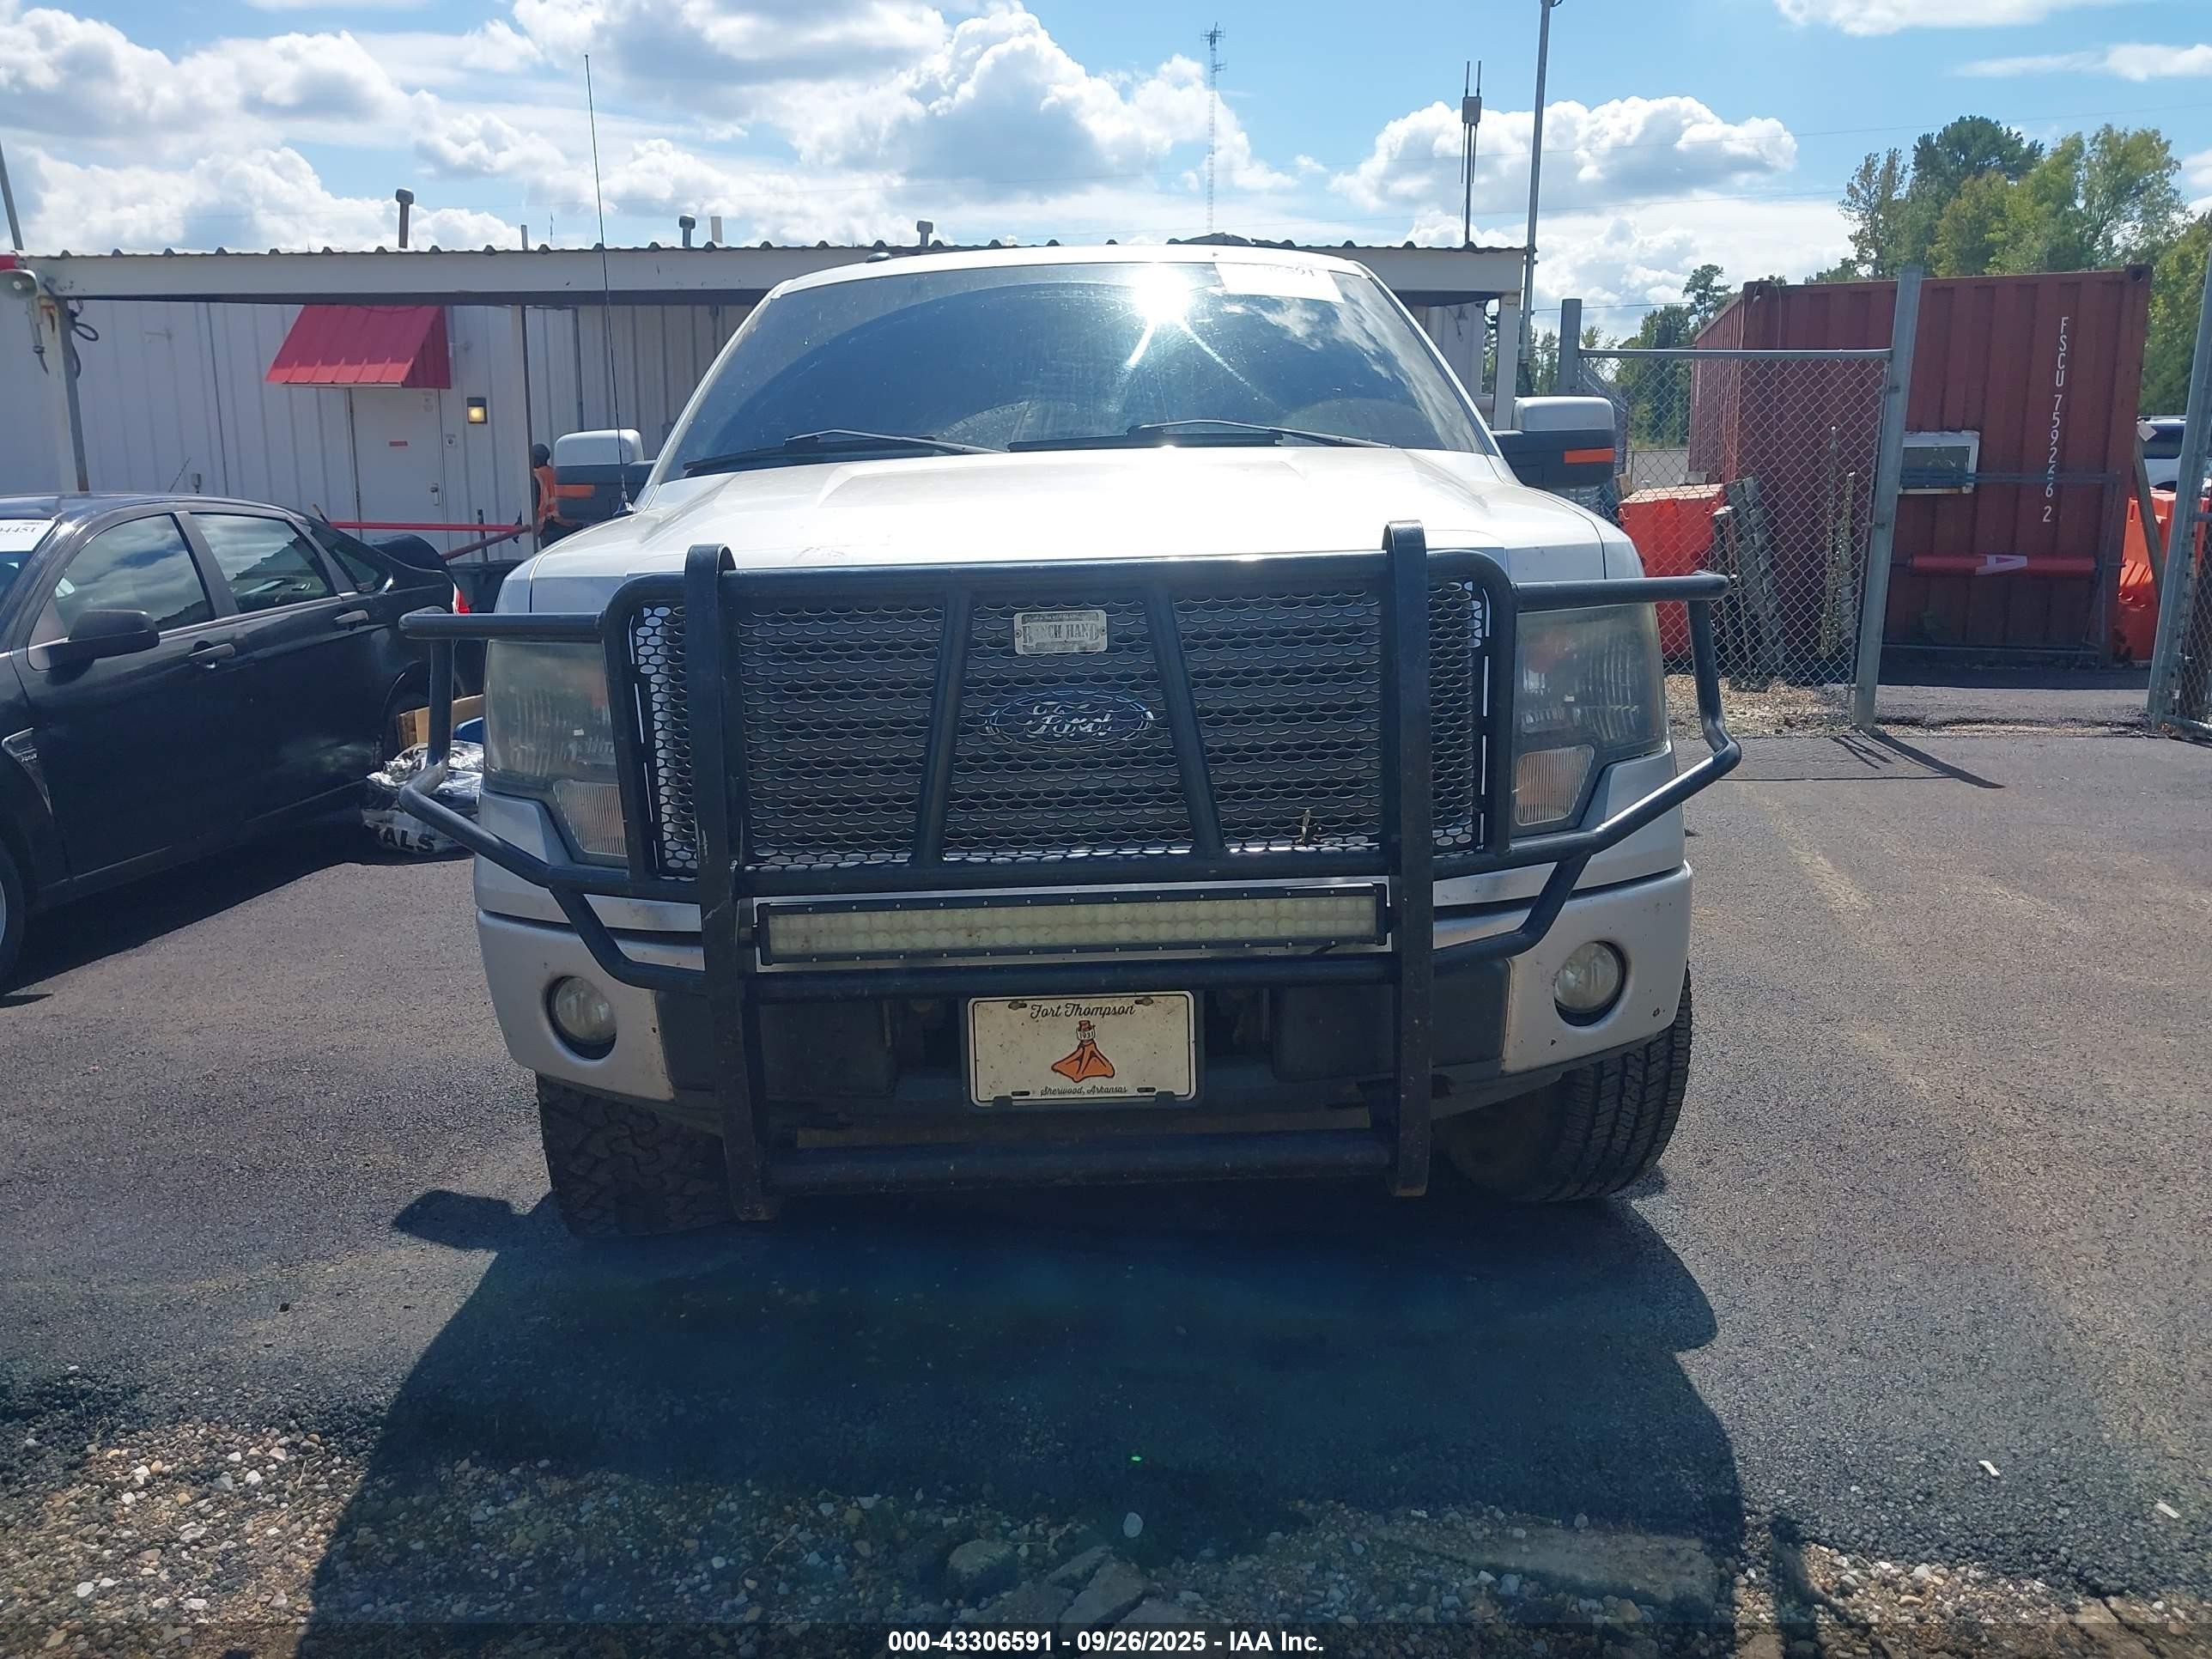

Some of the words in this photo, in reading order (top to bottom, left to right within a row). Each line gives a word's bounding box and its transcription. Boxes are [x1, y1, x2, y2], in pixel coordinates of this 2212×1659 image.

[2055, 316, 2069, 387] FSCU
[2042, 506, 2052, 522] 2
[1025, 702, 1114, 738] Ford
[1030, 1004, 1061, 1019] Fort
[1065, 1003, 1135, 1018] Thompson
[1040, 1086, 1085, 1096] Sherwood,
[1086, 1085, 1127, 1095] Arkansas
